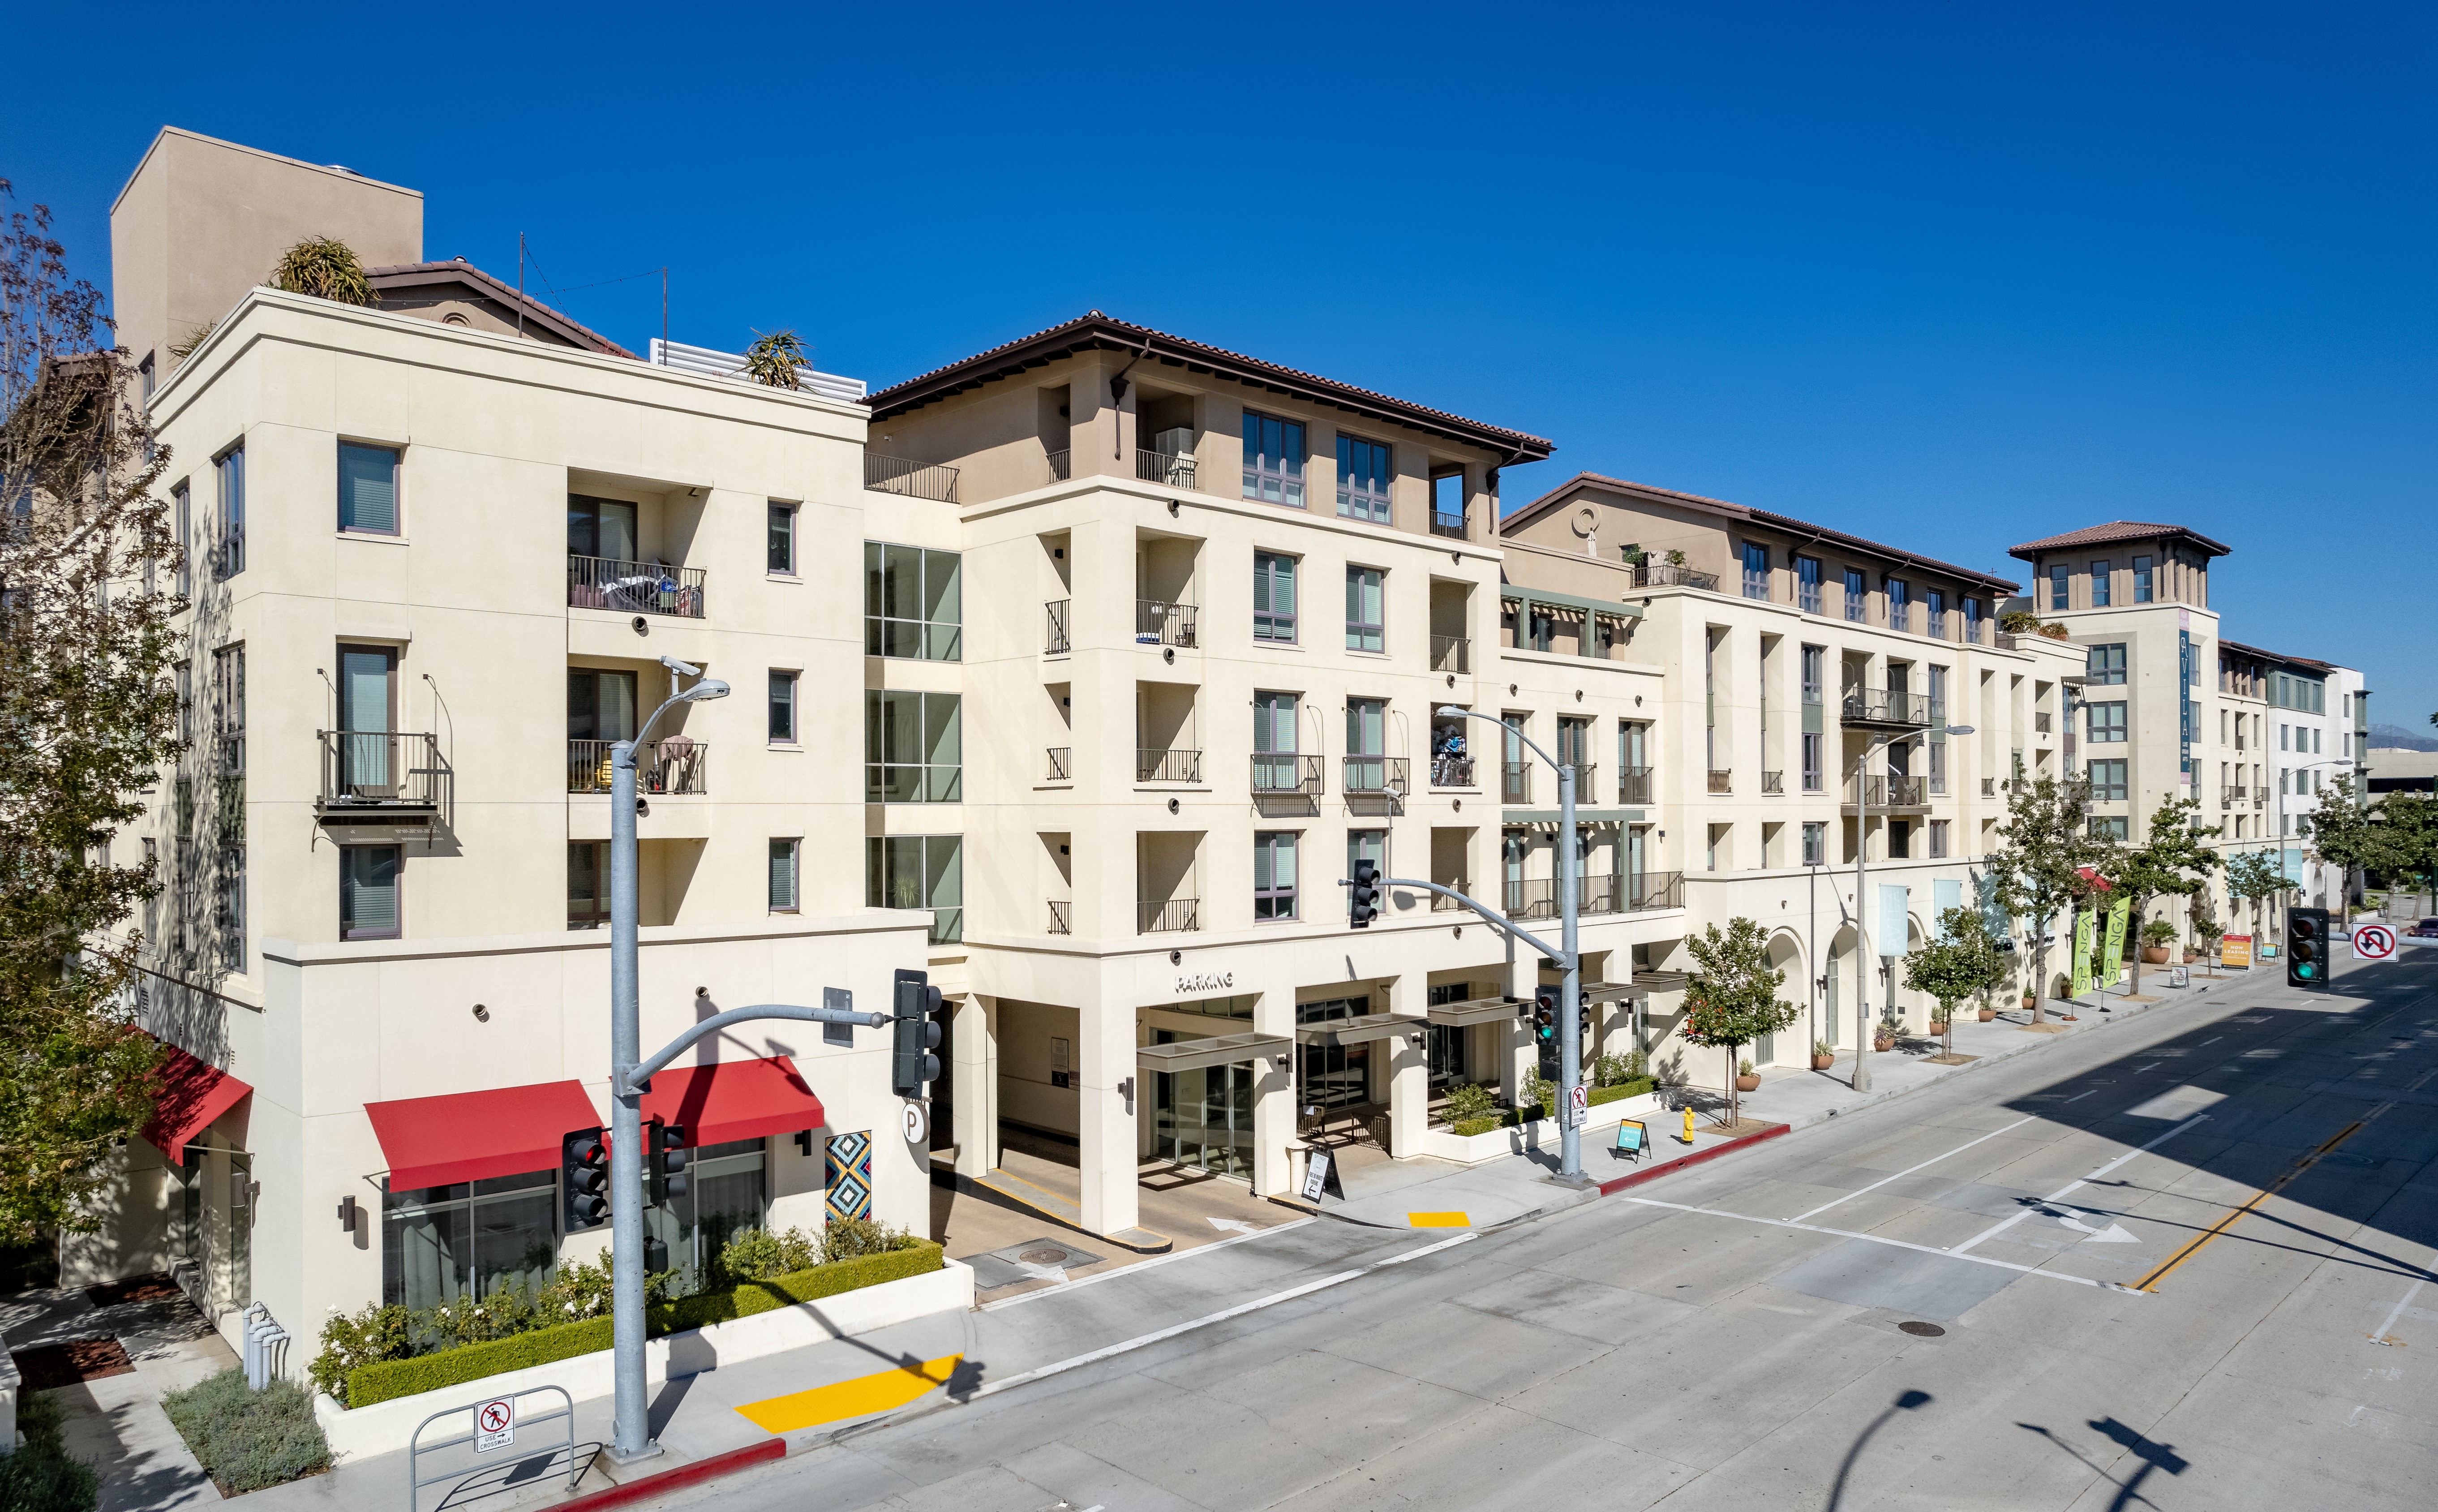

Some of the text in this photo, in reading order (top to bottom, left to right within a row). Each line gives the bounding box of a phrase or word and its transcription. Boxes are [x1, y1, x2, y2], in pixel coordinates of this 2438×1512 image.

[2076, 915, 2091, 990] SPENGA
[2105, 909, 2125, 981] SPENGA
[1175, 970, 1232, 993] PARKING
[907, 1111, 917, 1137] P
[480, 1437, 511, 1449] CROSSWALK
